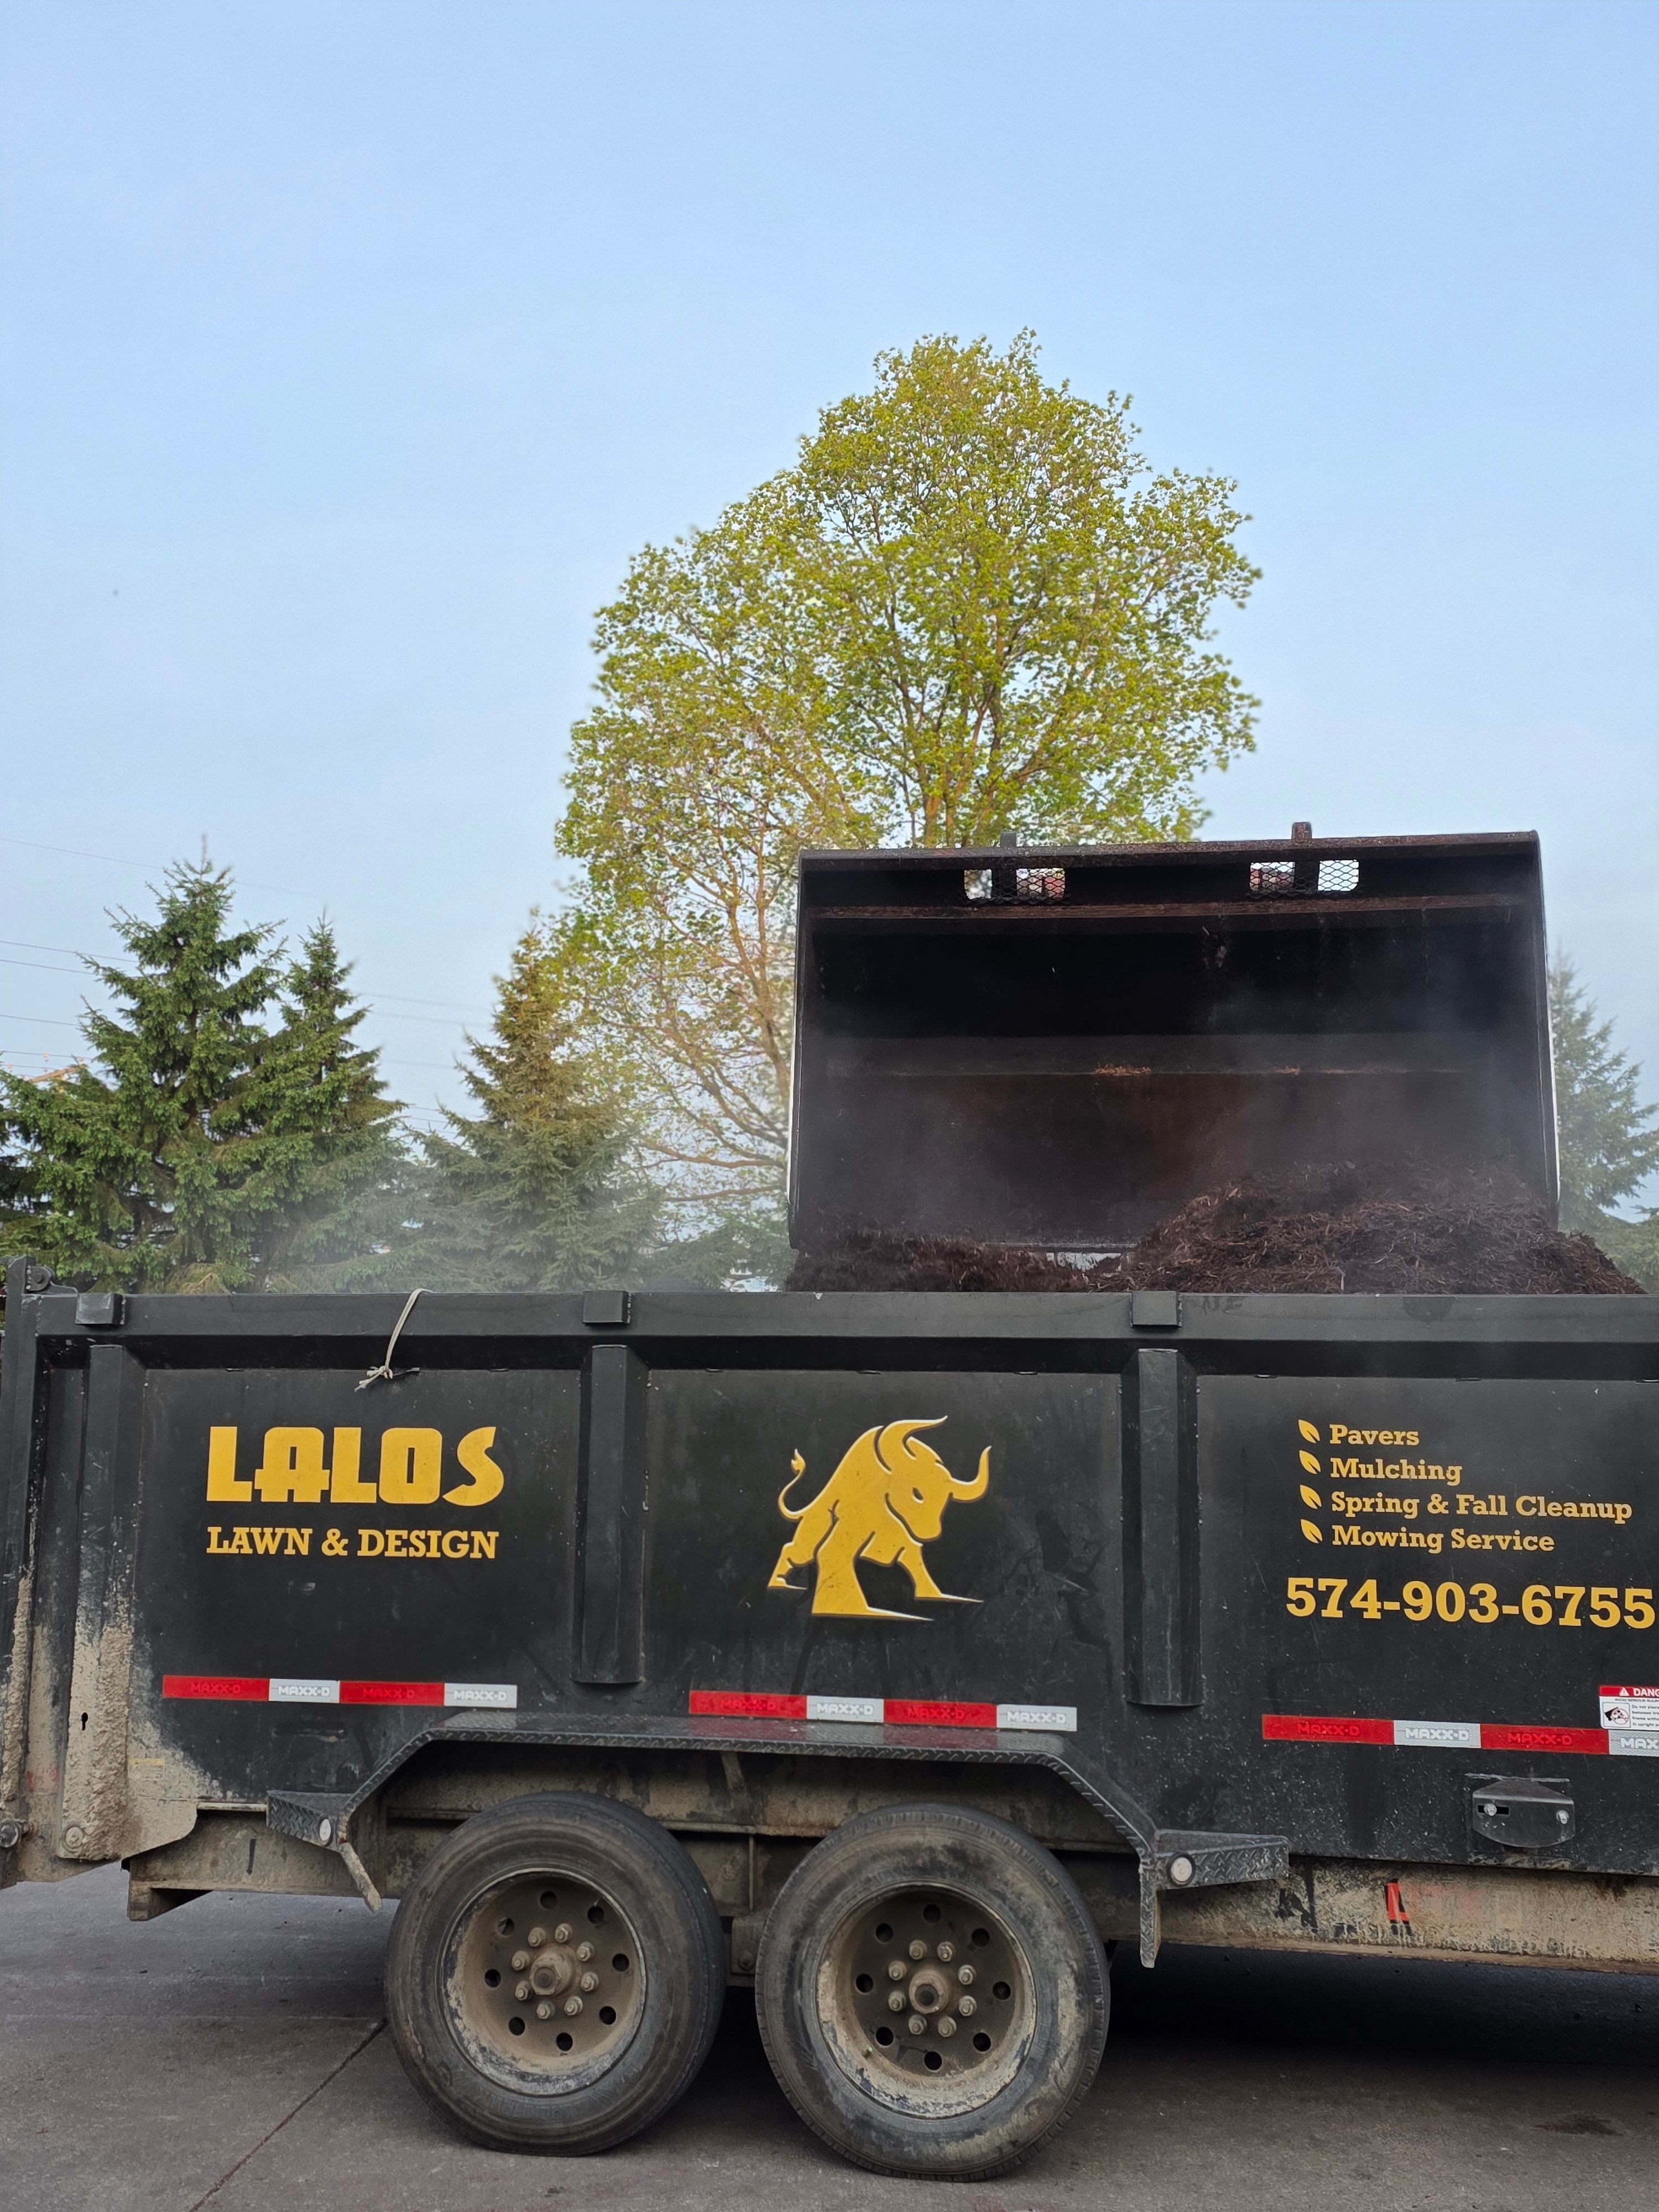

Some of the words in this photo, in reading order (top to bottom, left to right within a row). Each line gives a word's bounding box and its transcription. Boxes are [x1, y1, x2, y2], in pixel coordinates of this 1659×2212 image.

[1329, 1423, 1420, 1446] Pavers
[206, 1426, 504, 1506] LALOS
[1330, 1457, 1463, 1486] Mulching
[1331, 1491, 1420, 1519] Spring
[1427, 1493, 1449, 1514] &
[1456, 1494, 1507, 1516] Fall
[1515, 1495, 1632, 1524] Cleanup
[206, 1526, 313, 1556] LAWN
[321, 1528, 349, 1556] &
[357, 1529, 499, 1559] DESIGN
[1332, 1525, 1444, 1554] Mowing
[1451, 1528, 1555, 1551] Service
[1286, 1577, 1655, 1629] 574-903-6755
